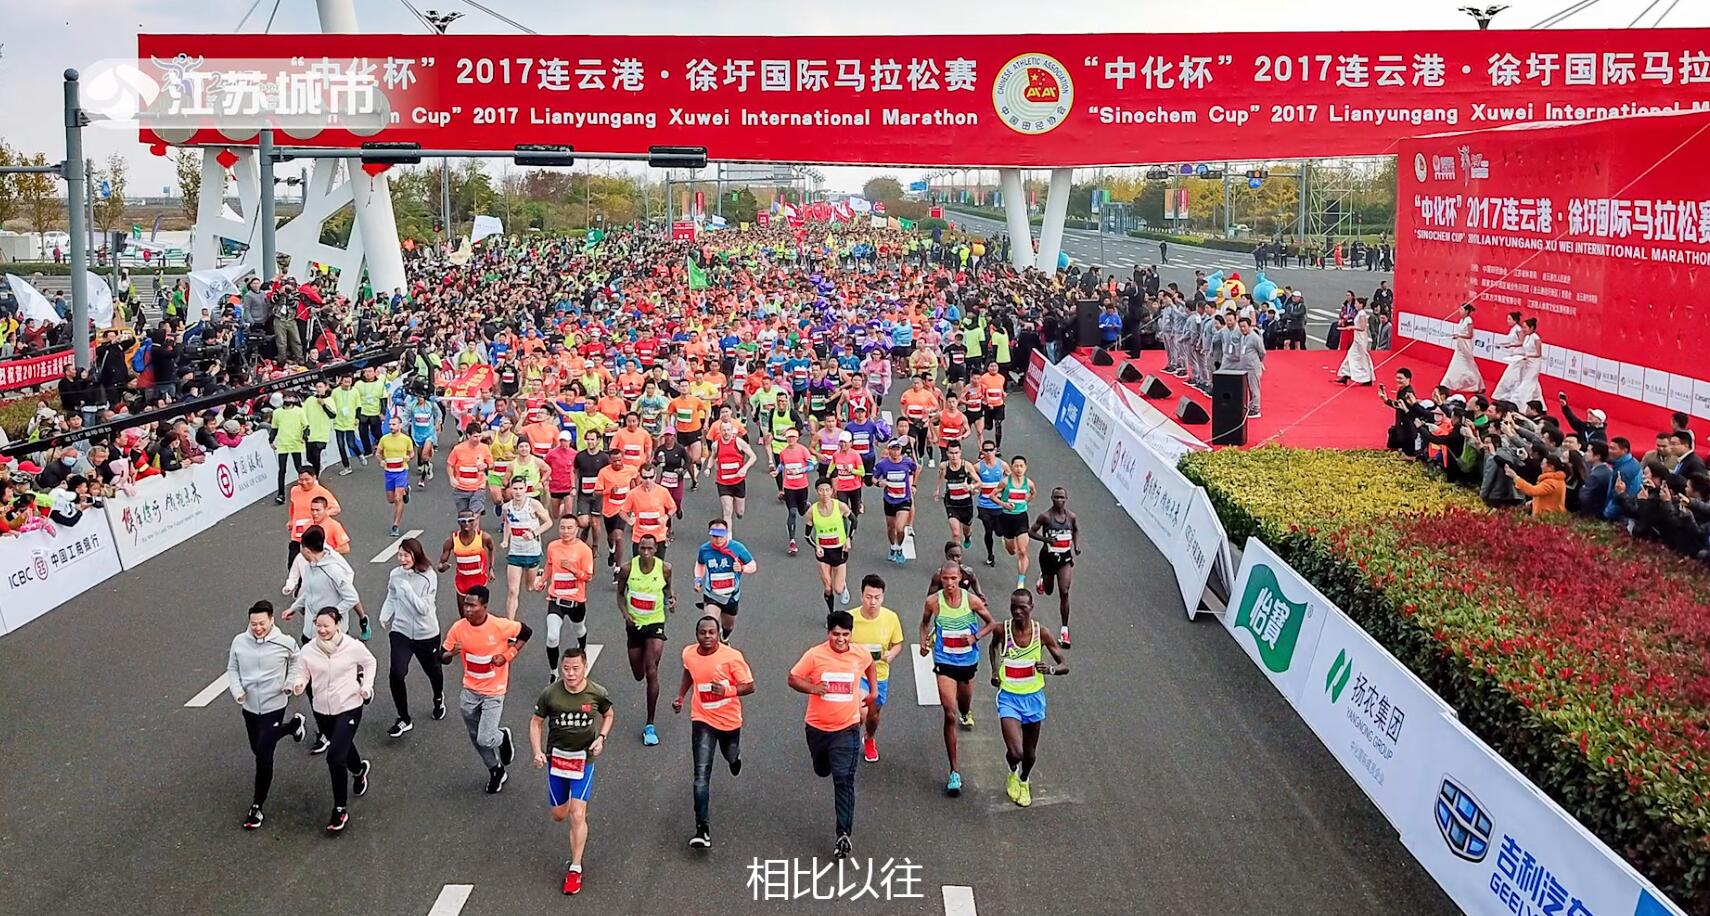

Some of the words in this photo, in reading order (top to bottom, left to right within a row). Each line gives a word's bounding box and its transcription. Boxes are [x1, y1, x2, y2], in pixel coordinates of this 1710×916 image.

[457, 56, 978, 93] 2017连云港·徐圩国际马拉松赛
[997, 68, 1013, 95] CHINESE
[1012, 57, 1041, 70] ATHLETIC
[1043, 60, 1070, 94] ASSOCIATION
[1084, 54, 1233, 91] “中化杯”
[412, 106, 462, 127] Cup”
[473, 107, 520, 124] 2017
[531, 107, 657, 129] Lianyungang
[669, 108, 730, 126] Xuwei
[742, 108, 871, 126] International
[883, 108, 978, 126] Marathon
[1088, 105, 1196, 124] “Sinochem
[1209, 105, 1261, 126] Cup”
[1271, 105, 1318, 123] 2017
[1329, 104, 1458, 126] Lianyungang
[1470, 103, 1534, 121] Xuwei
[1414, 194, 1462, 227] “中化杯”
[1575, 242, 1648, 260] INTERNATIONAL
[50, 533, 100, 567] 中国工商银行
[8, 567, 33, 589] ICBC
[1350, 671, 1405, 746] 扬农集团
[1346, 706, 1373, 743] YANGNONG
[1372, 735, 1393, 760] GROUP
